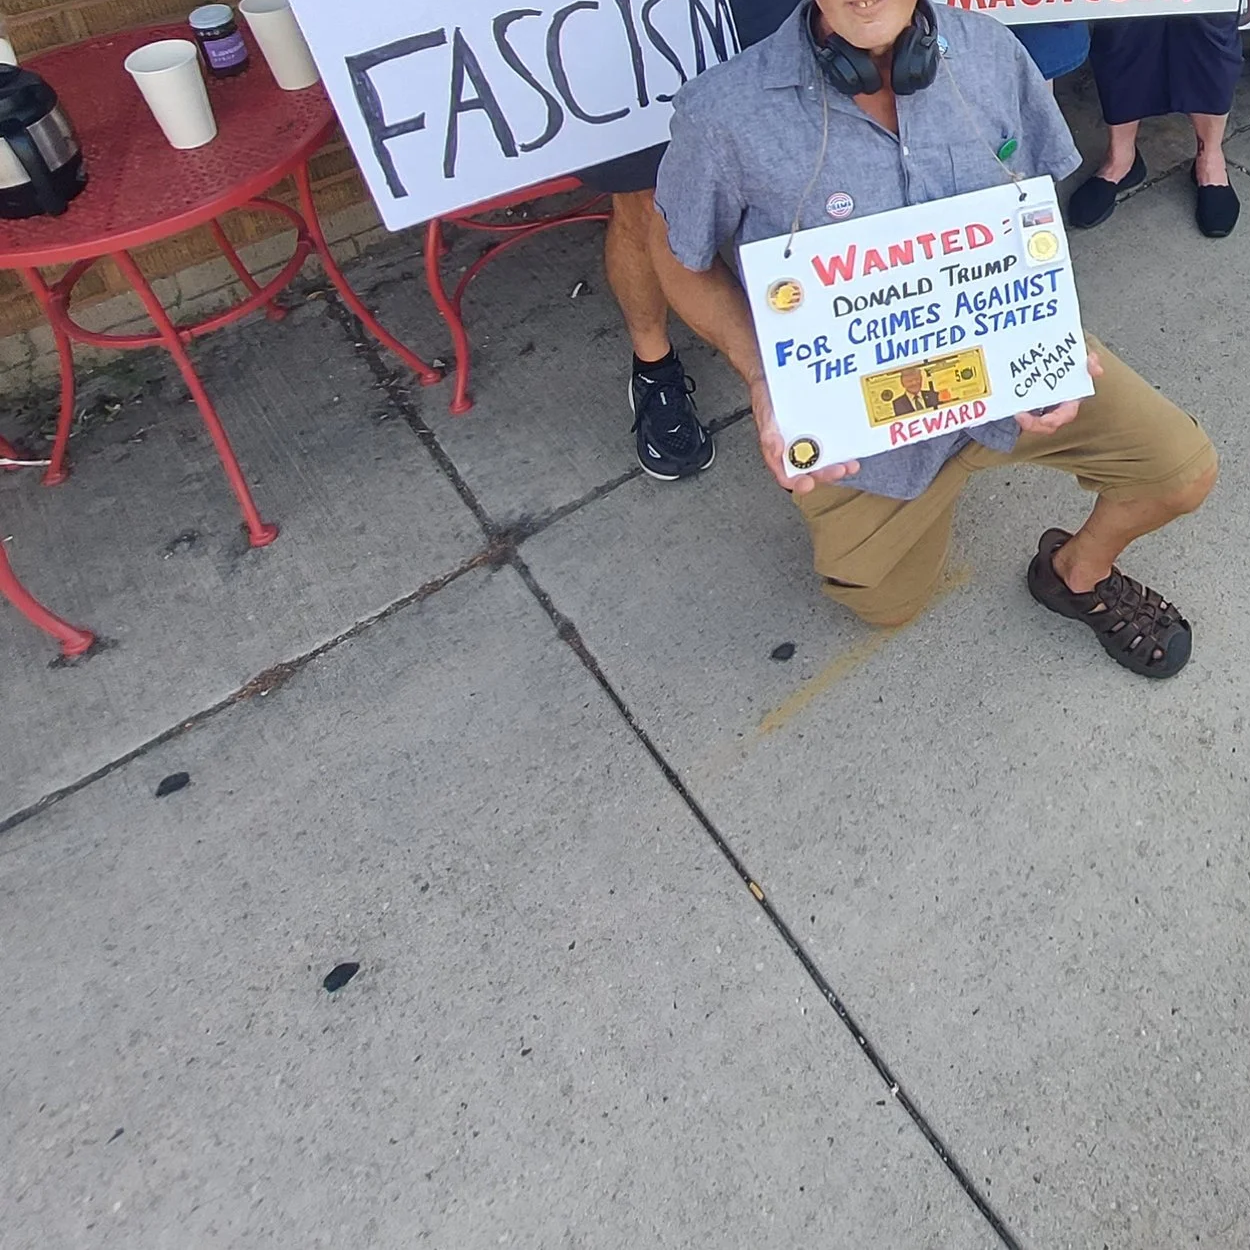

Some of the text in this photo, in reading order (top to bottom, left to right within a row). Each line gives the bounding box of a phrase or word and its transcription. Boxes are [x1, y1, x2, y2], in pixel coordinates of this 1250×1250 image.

[775, 267, 1065, 368] FOR CRIMES AGAINST
[832, 254, 1018, 318] DONALD TRUMP
[806, 298, 1059, 384] THE UNITED STATES
[1009, 342, 1046, 379] AKA:
[1014, 365, 1042, 398] CON
[1042, 331, 1078, 372] MAN
[1043, 354, 1076, 391] DON
[889, 399, 987, 447] REWARD
